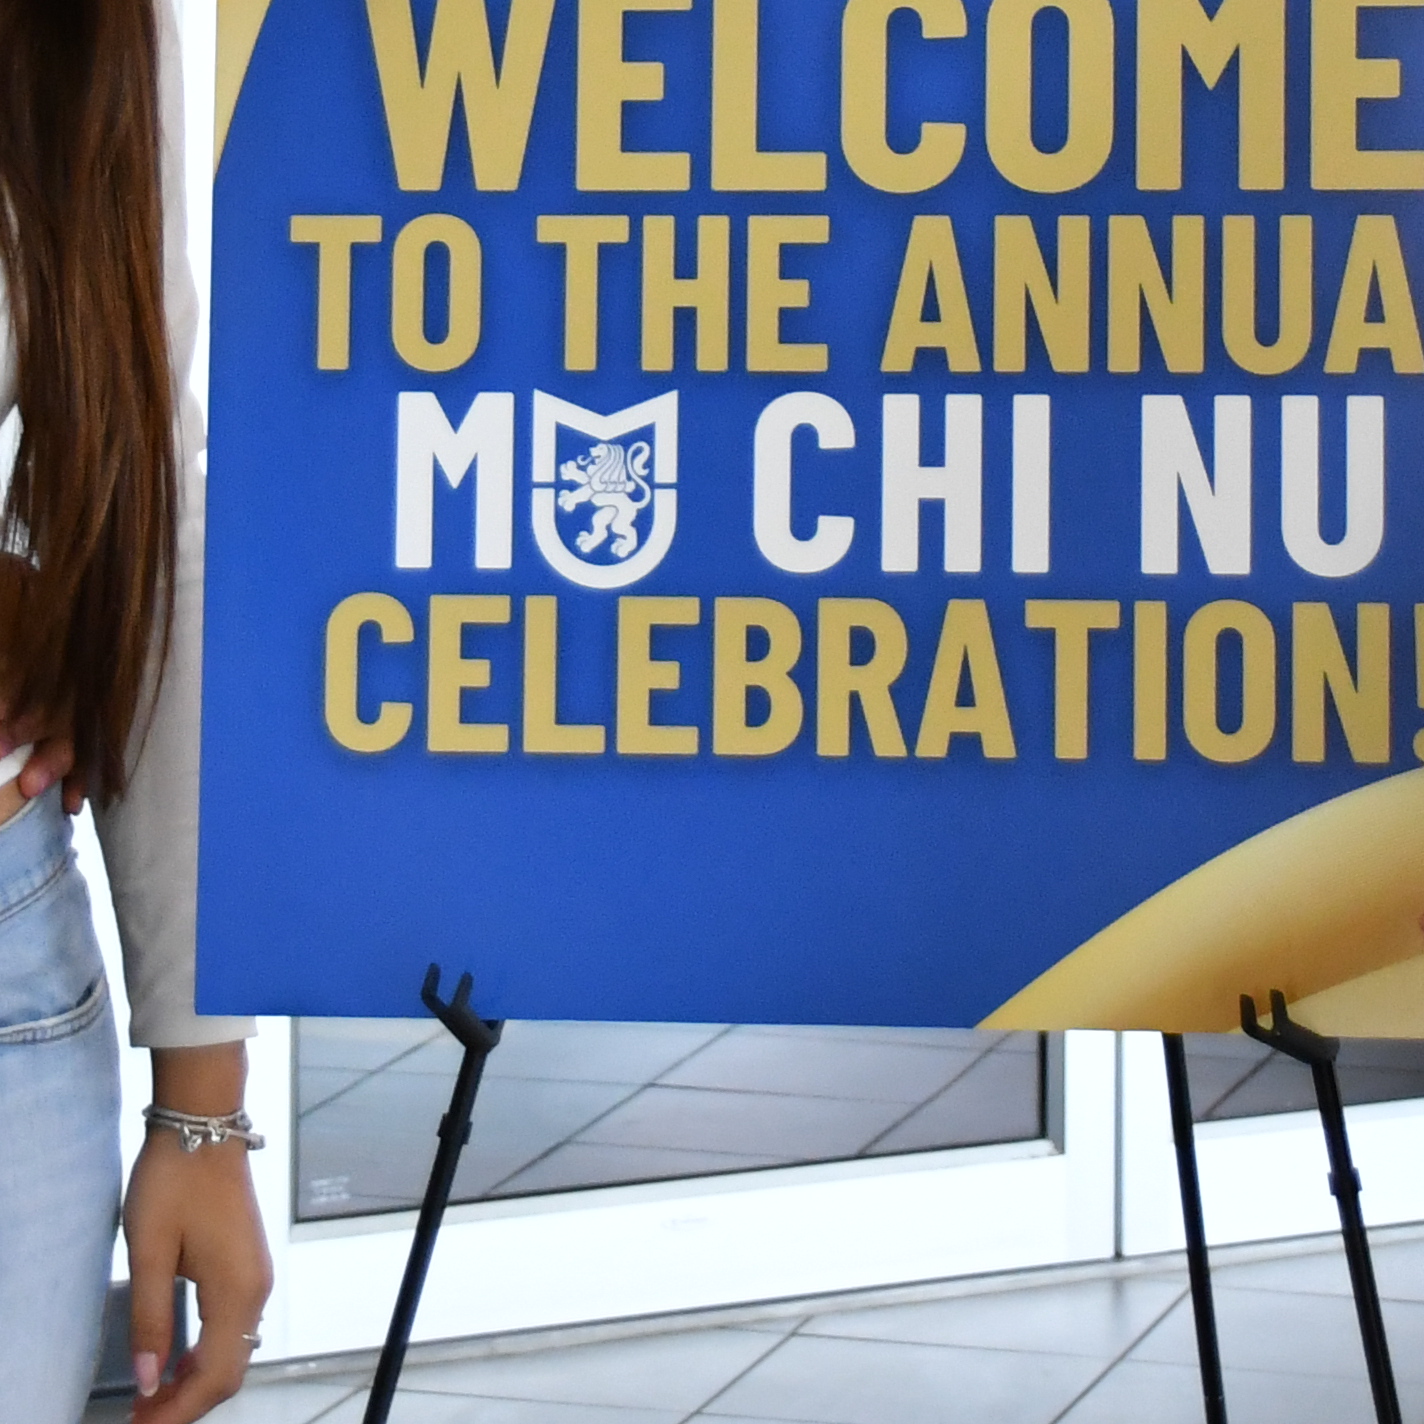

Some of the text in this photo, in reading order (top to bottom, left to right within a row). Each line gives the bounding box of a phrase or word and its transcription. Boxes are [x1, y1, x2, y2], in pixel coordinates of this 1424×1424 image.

[289, 212, 483, 373] TO
[536, 213, 830, 374] THE
[752, 391, 1051, 575] CHI
[1140, 393, 1386, 578] NU
